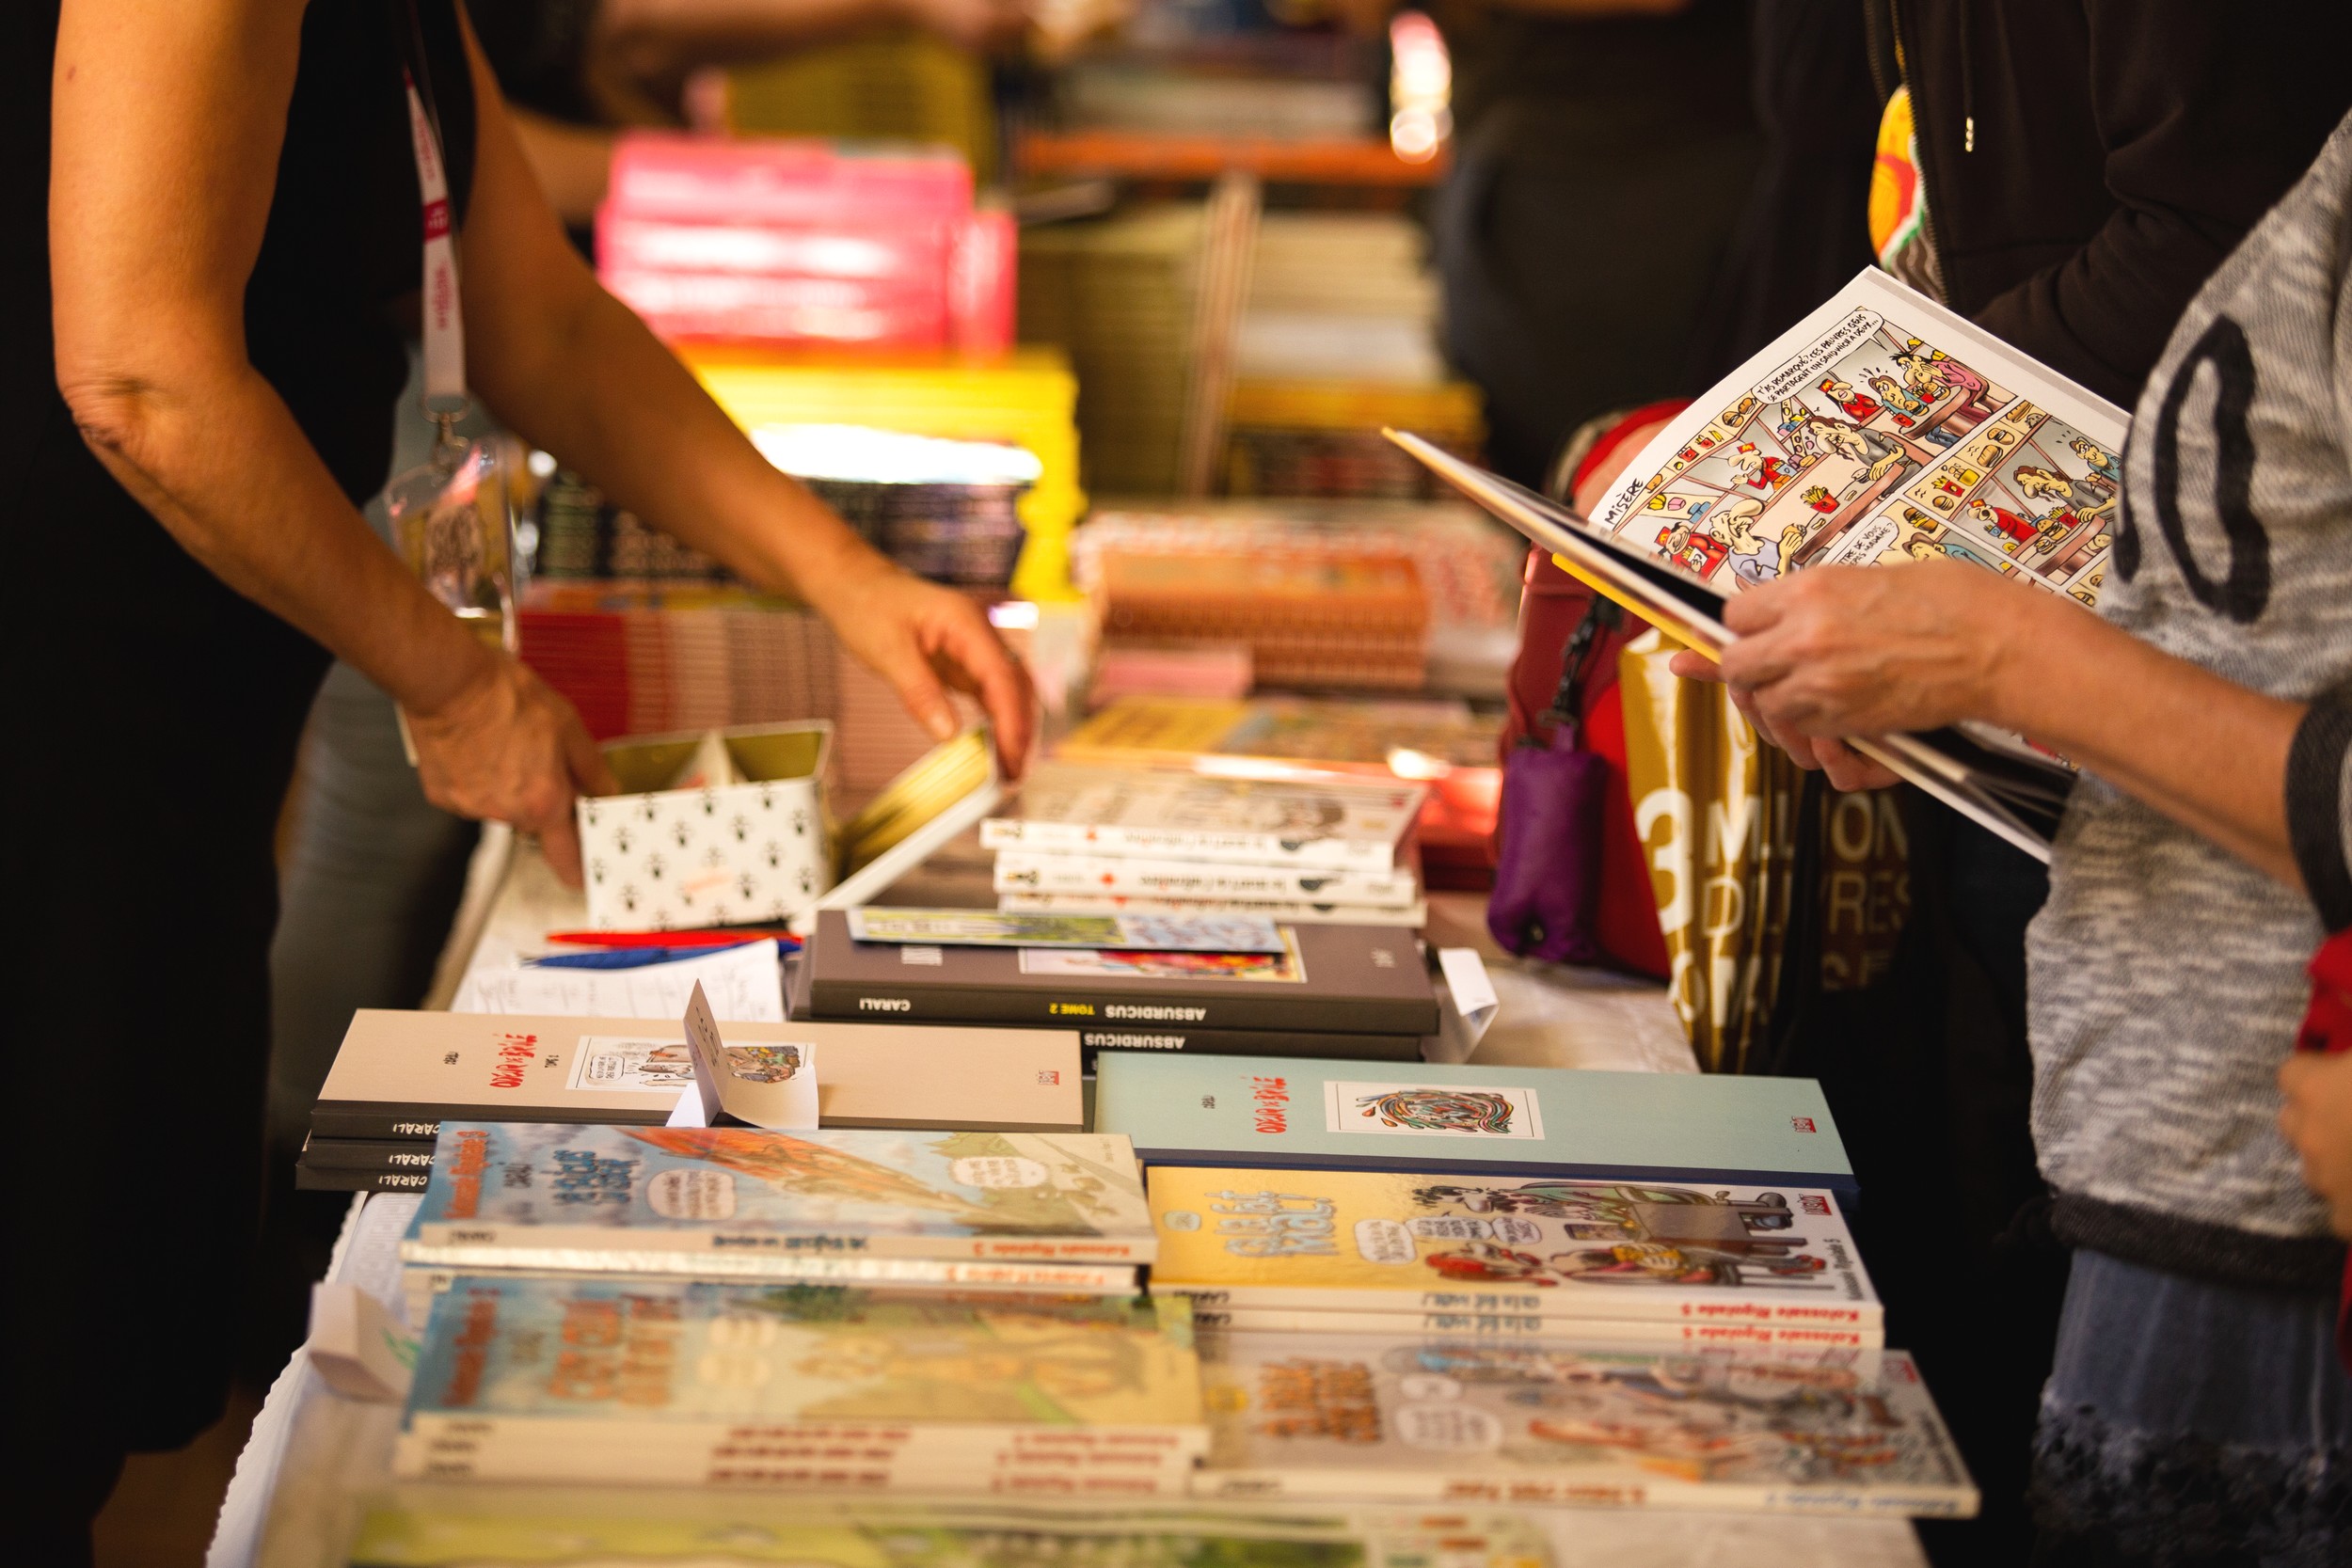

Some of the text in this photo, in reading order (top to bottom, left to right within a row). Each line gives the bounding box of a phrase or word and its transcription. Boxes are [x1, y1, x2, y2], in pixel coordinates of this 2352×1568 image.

[1854, 540, 1865, 549] DE
[1863, 525, 1881, 541] VOUS
[1634, 786, 1693, 936] 3
[858, 997, 911, 1012] CARALI
[1049, 1002, 1207, 1022] ABSURDICUS TOME 2
[1084, 1031, 1185, 1050] ABSURDICUS
[393, 1122, 441, 1135] CARALI
[389, 1153, 437, 1166] CARALI
[378, 1174, 428, 1187] CARALI
